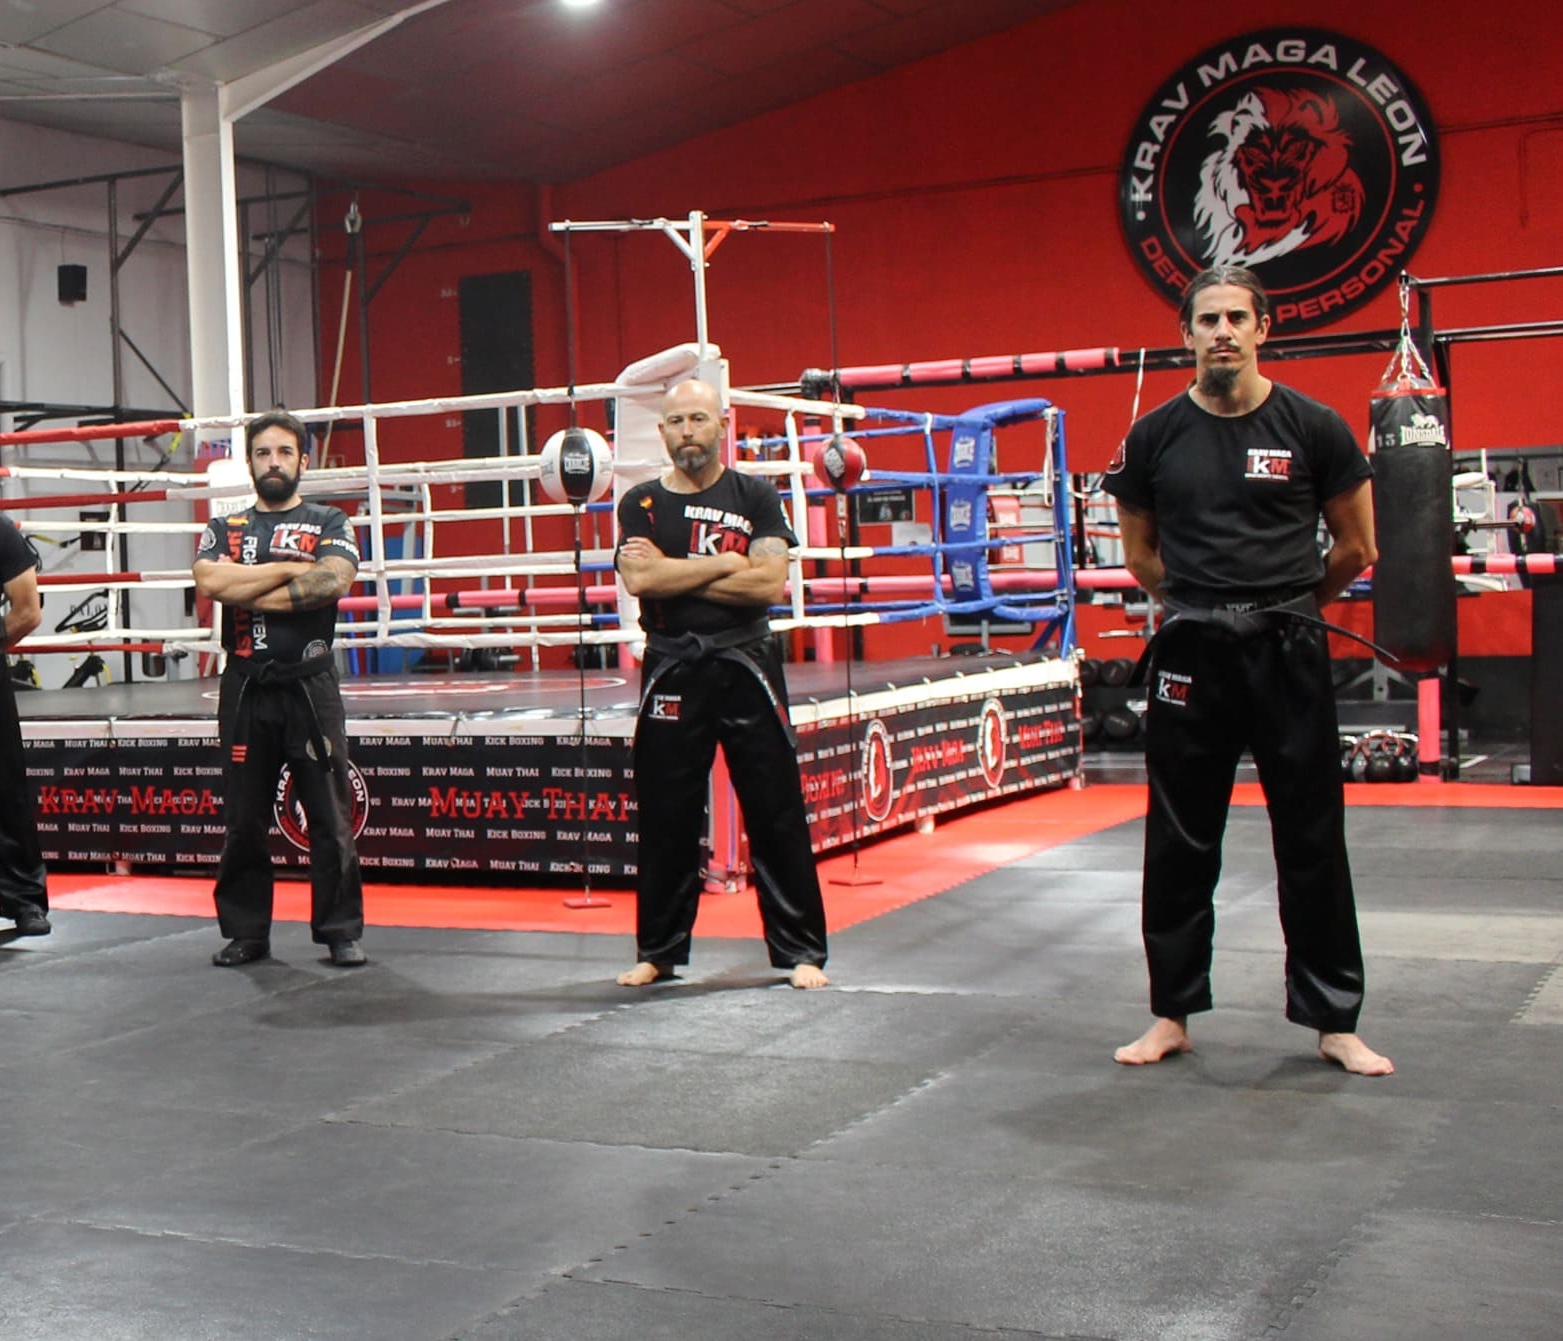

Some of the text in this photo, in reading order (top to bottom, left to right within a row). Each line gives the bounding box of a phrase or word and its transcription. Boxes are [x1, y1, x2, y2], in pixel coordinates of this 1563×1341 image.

[1130, 39, 1427, 203] KRAV MAGA LEON
[1276, 200, 1424, 323] PERSONAL
[684, 505, 723, 522] KRAV
[40, 785, 217, 815] KRAV MAGA
[276, 770, 291, 802] KRA
[429, 786, 630, 821] MUAY THAI
